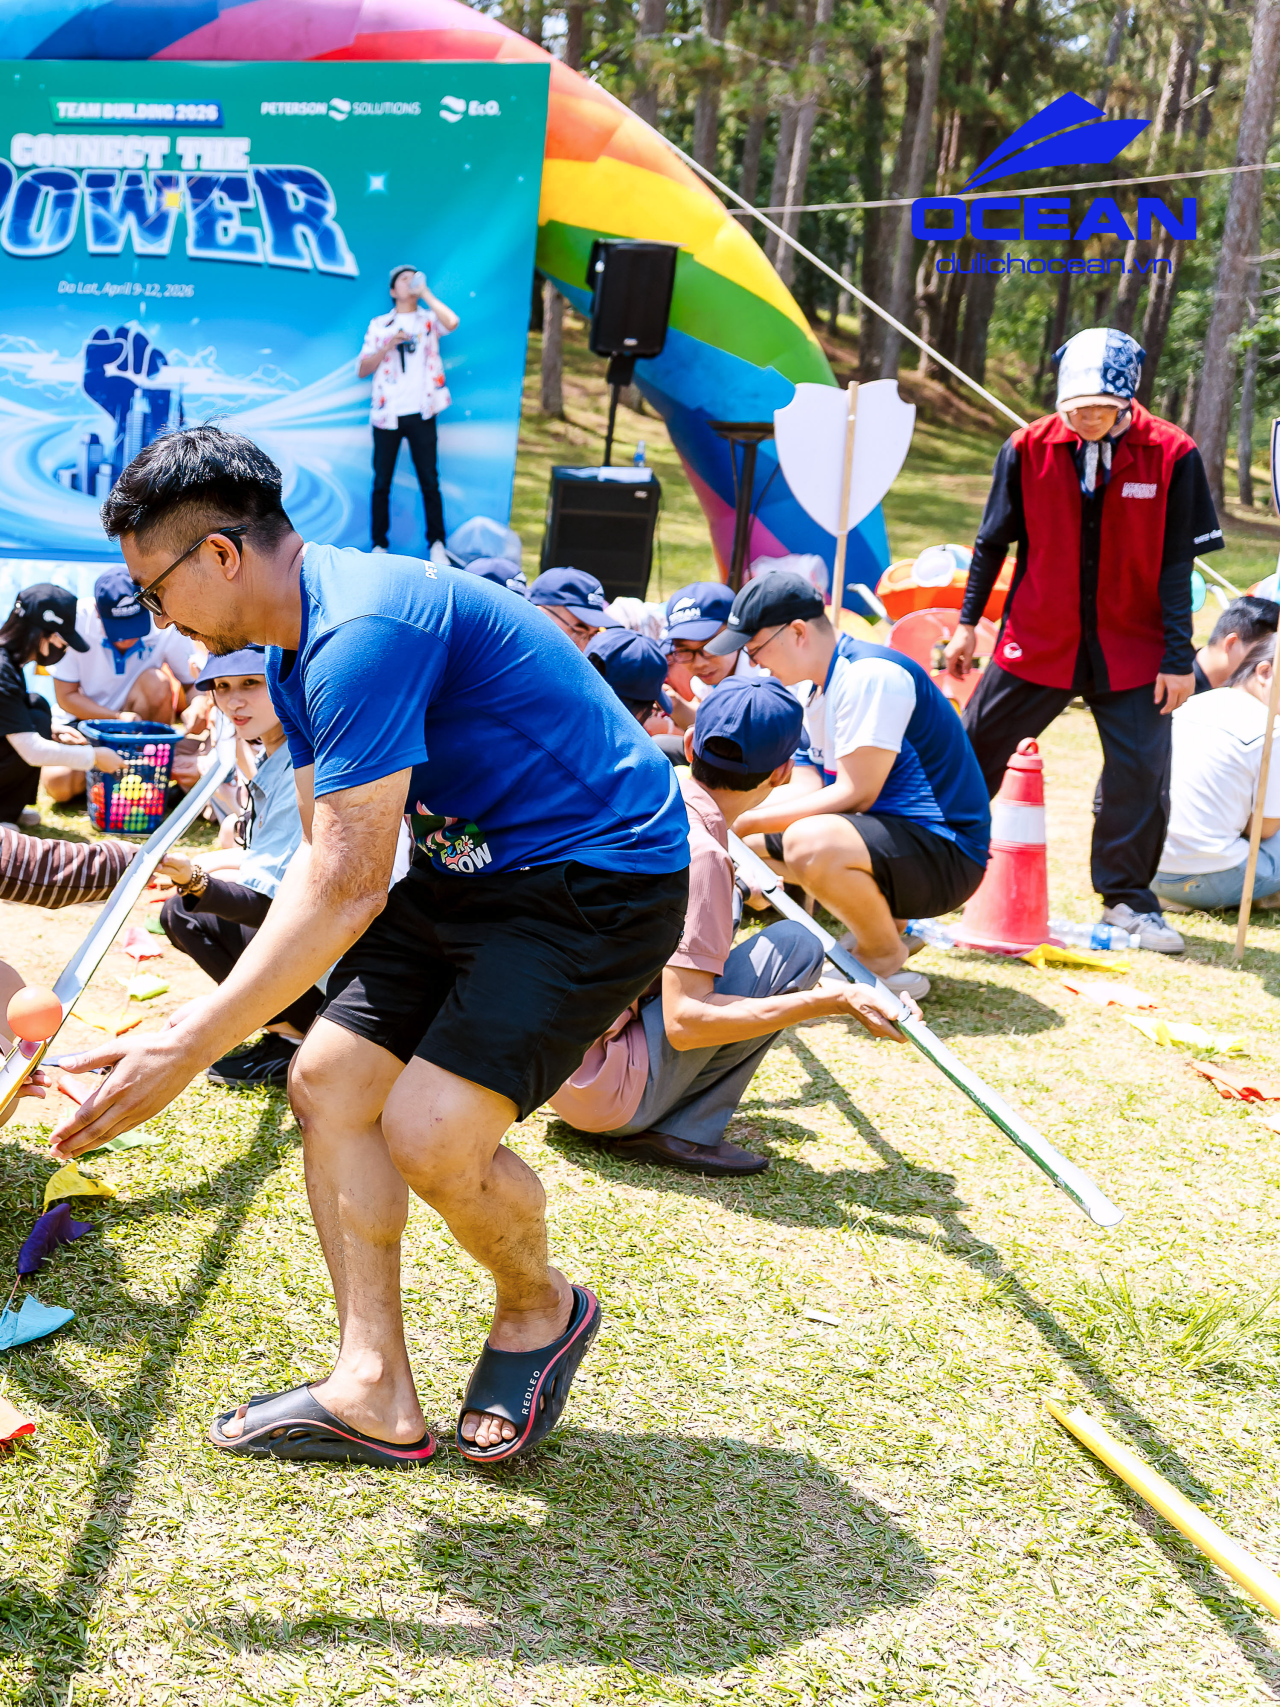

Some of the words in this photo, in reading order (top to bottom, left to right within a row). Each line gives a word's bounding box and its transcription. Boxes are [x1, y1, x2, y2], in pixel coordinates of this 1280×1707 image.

[56, 101, 101, 118] TEAM
[102, 103, 175, 121] BUILDING
[176, 103, 219, 122] 2026
[260, 101, 329, 115] PETERSON
[352, 101, 421, 116] SOLUTIONS
[10, 133, 171, 168] CONNECT
[176, 136, 251, 170] THE
[77, 282, 101, 296] Lat,
[102, 282, 132, 298] April
[163, 284, 195, 298] 2026
[521, 1370, 540, 1415] REDLEO
